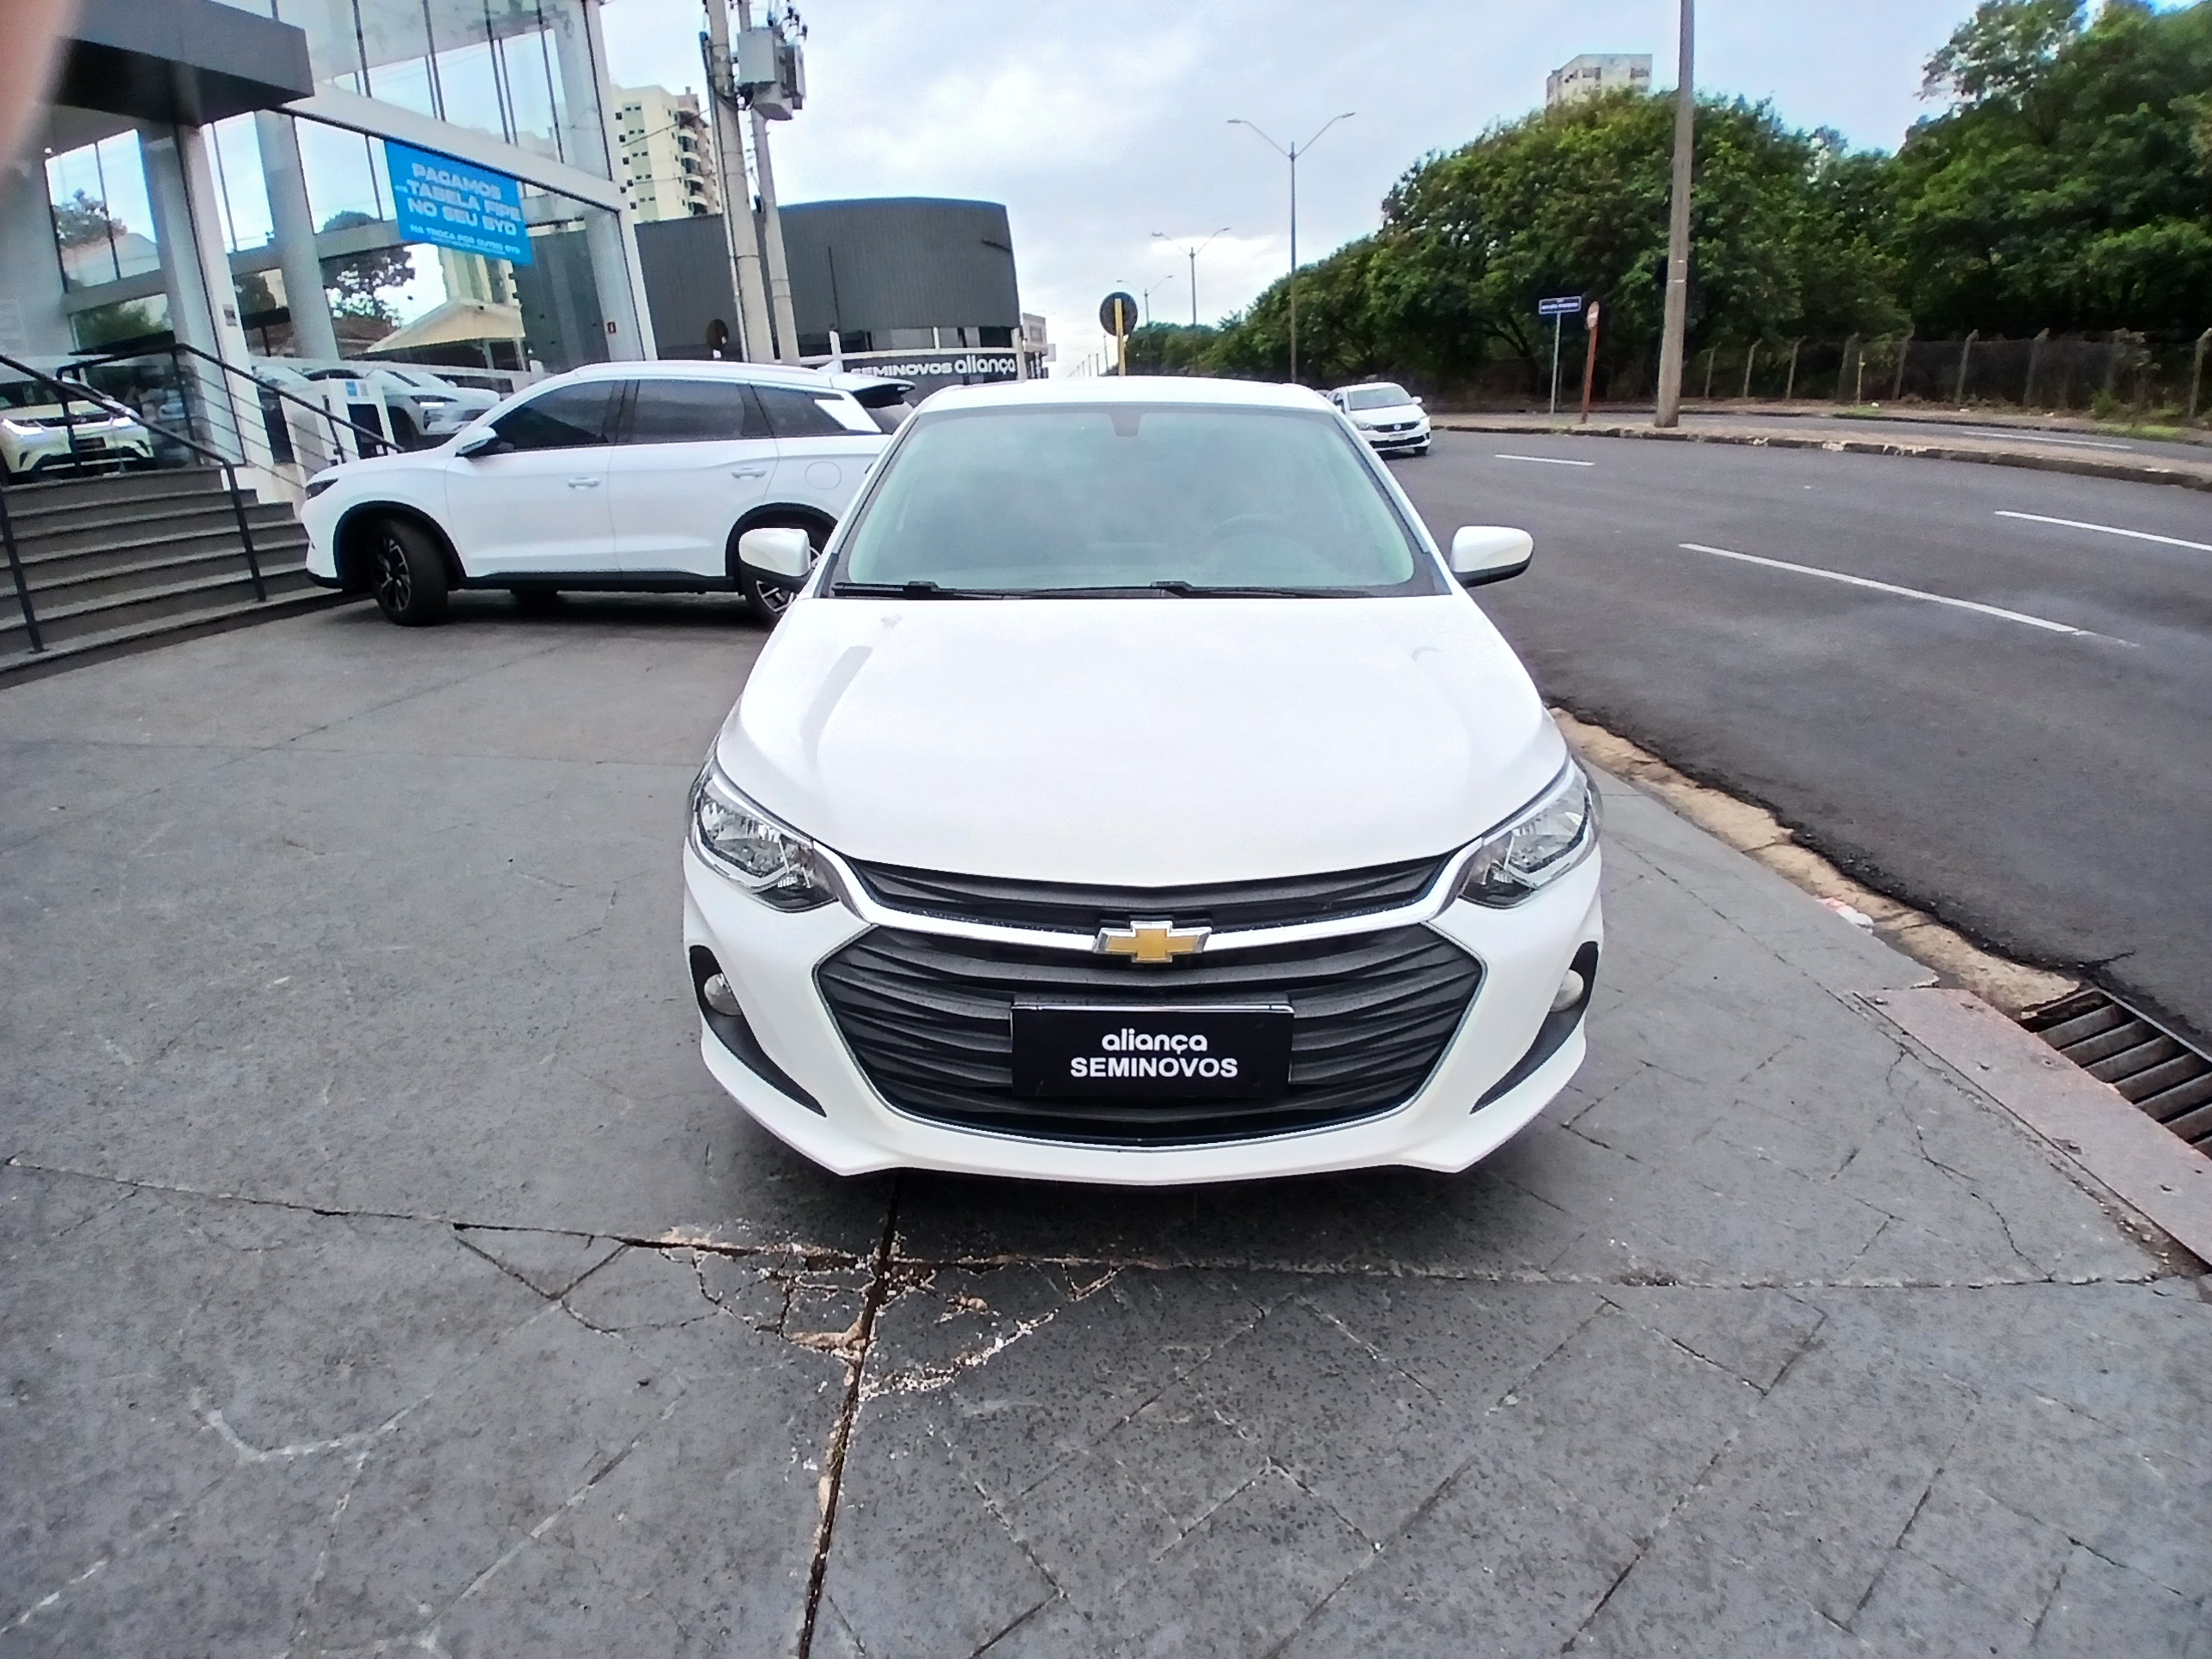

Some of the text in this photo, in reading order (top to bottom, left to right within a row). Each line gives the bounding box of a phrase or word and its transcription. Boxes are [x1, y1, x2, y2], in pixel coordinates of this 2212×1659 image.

[411, 162, 501, 200] PAGAMOS
[406, 179, 521, 222] TABELA FIPE
[407, 198, 516, 235] NO SEU BYD
[955, 355, 1017, 375] aliança
[1102, 1029, 1208, 1054] aliança
[1071, 1057, 1238, 1078] SEMINOVOS
